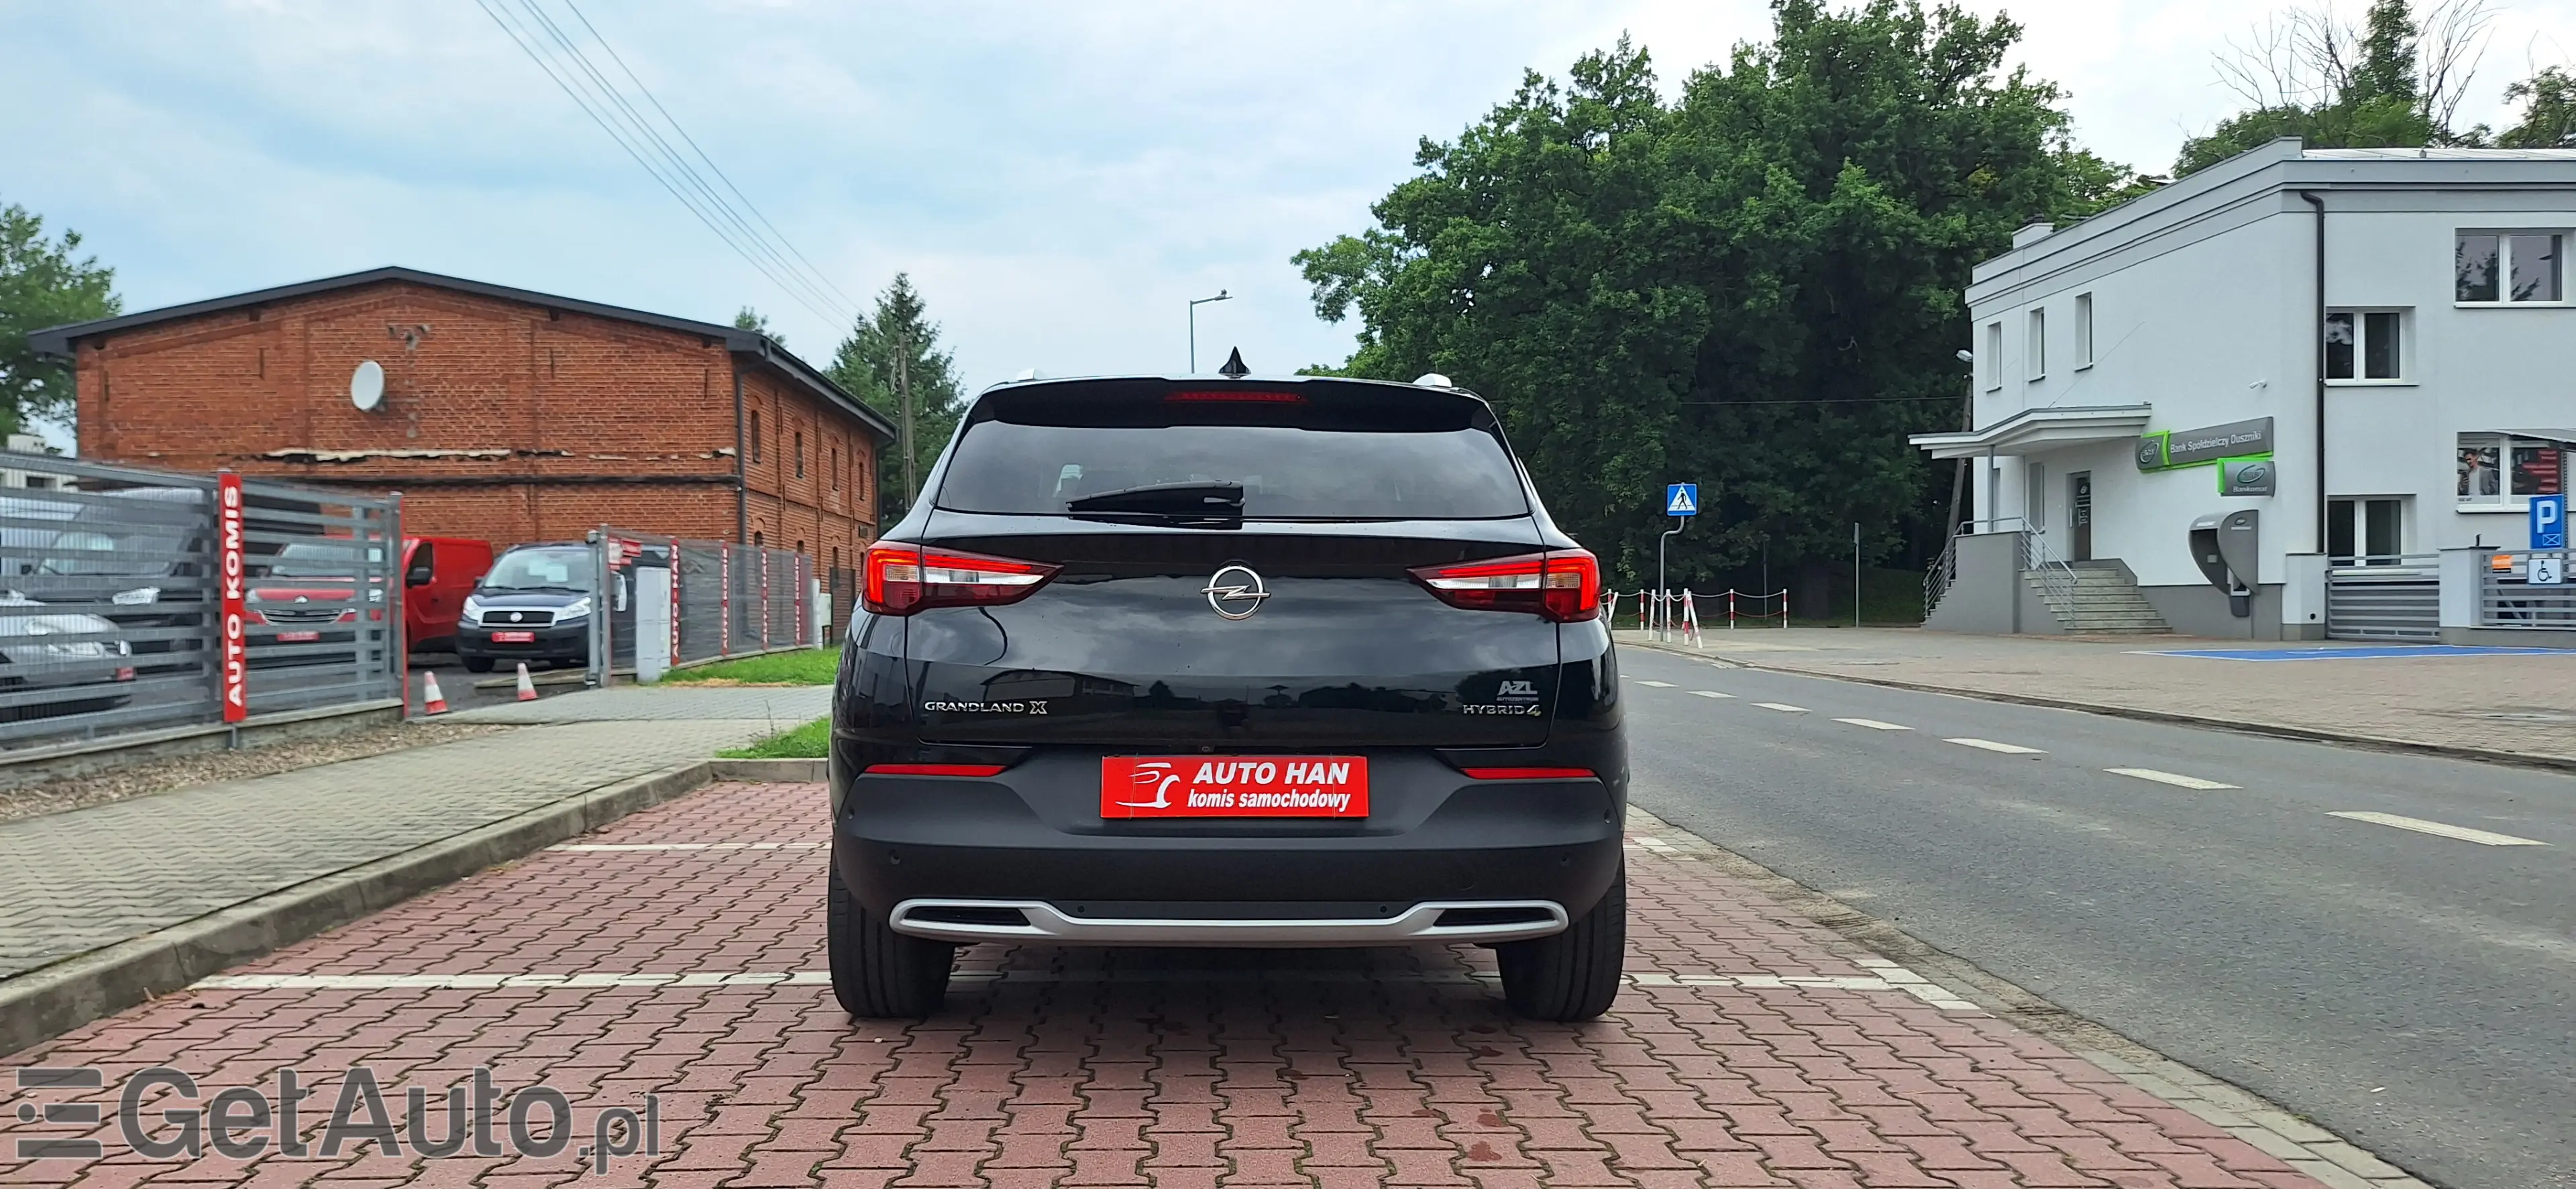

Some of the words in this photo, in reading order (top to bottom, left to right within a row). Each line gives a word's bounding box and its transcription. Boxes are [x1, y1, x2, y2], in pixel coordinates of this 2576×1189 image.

[2170, 443, 2187, 453] Bank
[2231, 431, 2261, 444] Duszniki
[2536, 500, 2557, 534] P
[224, 486, 241, 600] KOMIS
[227, 614, 243, 707] AUTO
[1497, 681, 1538, 695] AZL
[924, 701, 1024, 712] GRANDLAND
[1029, 701, 1048, 714] X
[1192, 762, 1276, 785] AUTO
[1284, 762, 1350, 785] HAN
[1187, 789, 1235, 807] komis
[1238, 789, 1351, 812] samochodowy
